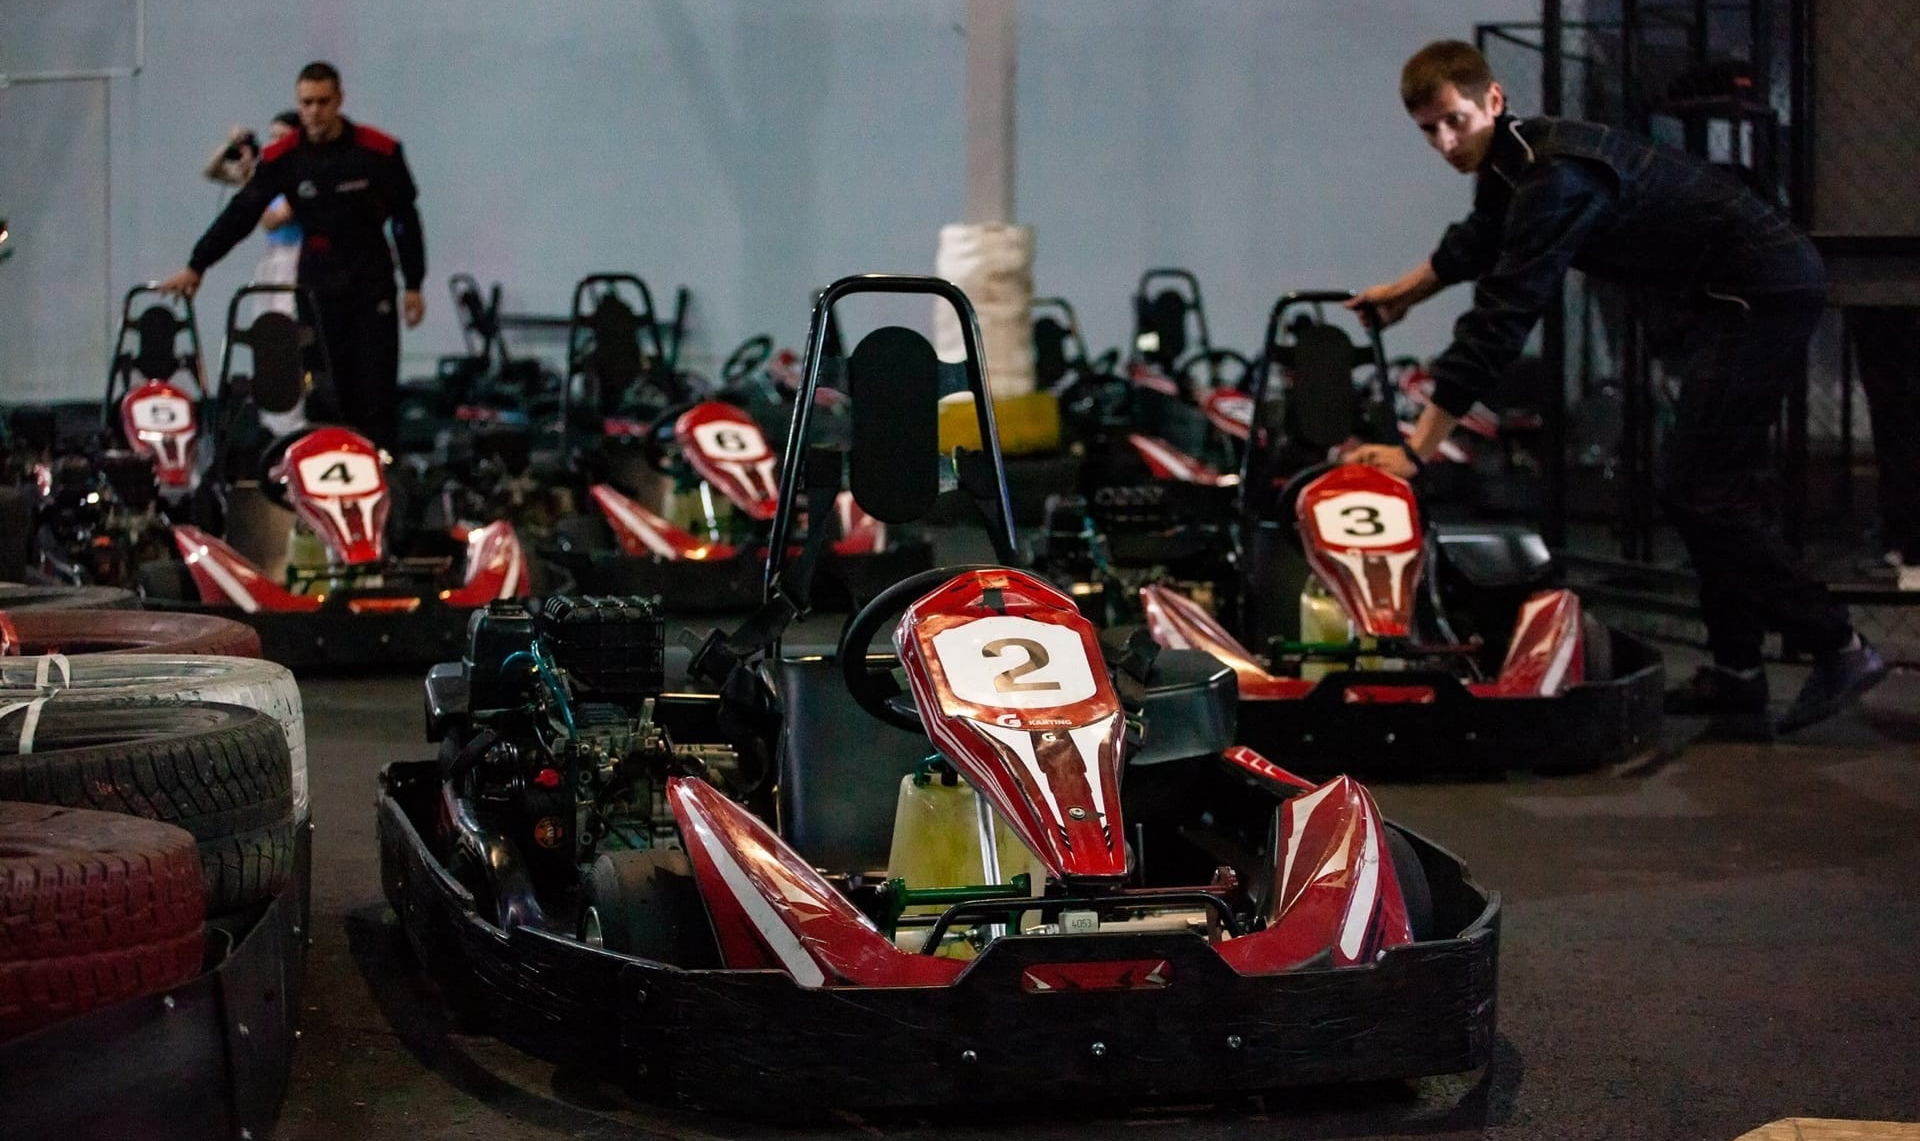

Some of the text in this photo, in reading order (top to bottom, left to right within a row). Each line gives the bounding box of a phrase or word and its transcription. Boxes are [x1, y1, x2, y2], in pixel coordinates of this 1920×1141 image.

[150, 406, 176, 424] 5
[715, 429, 746, 452] 6
[319, 463, 353, 484] 4
[1340, 506, 1385, 537] 3
[981, 637, 1061, 693] 2
